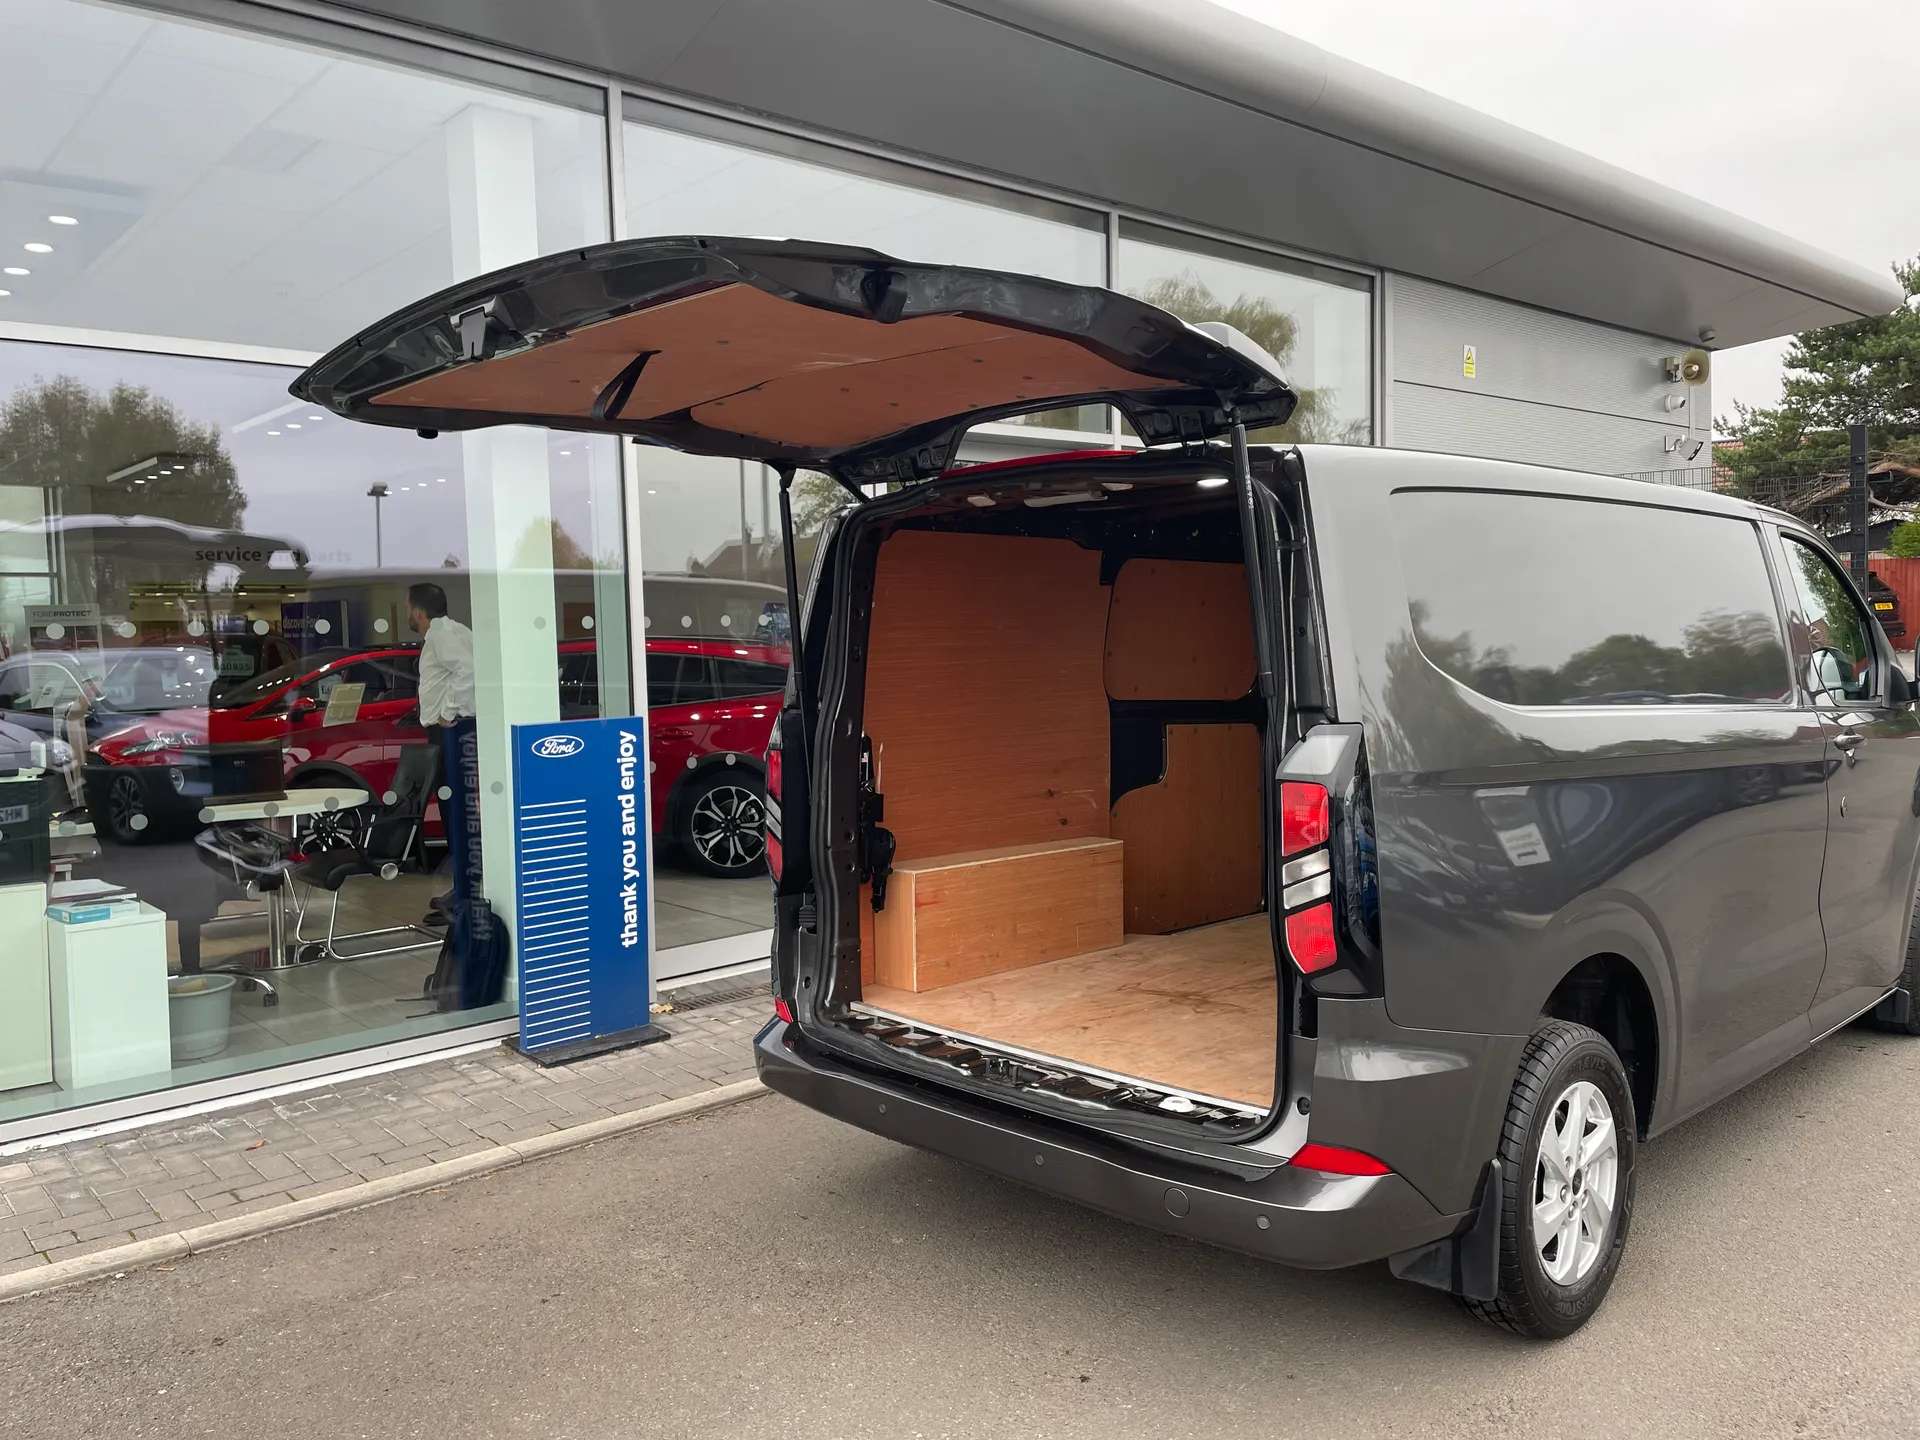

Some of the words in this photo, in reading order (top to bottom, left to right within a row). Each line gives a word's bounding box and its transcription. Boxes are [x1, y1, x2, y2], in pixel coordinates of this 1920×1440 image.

[194, 546, 262, 562] service
[538, 737, 578, 755] Ford
[616, 730, 637, 790] enjoy
[617, 793, 636, 836] and
[623, 839, 640, 881] you
[620, 883, 638, 948] thank
